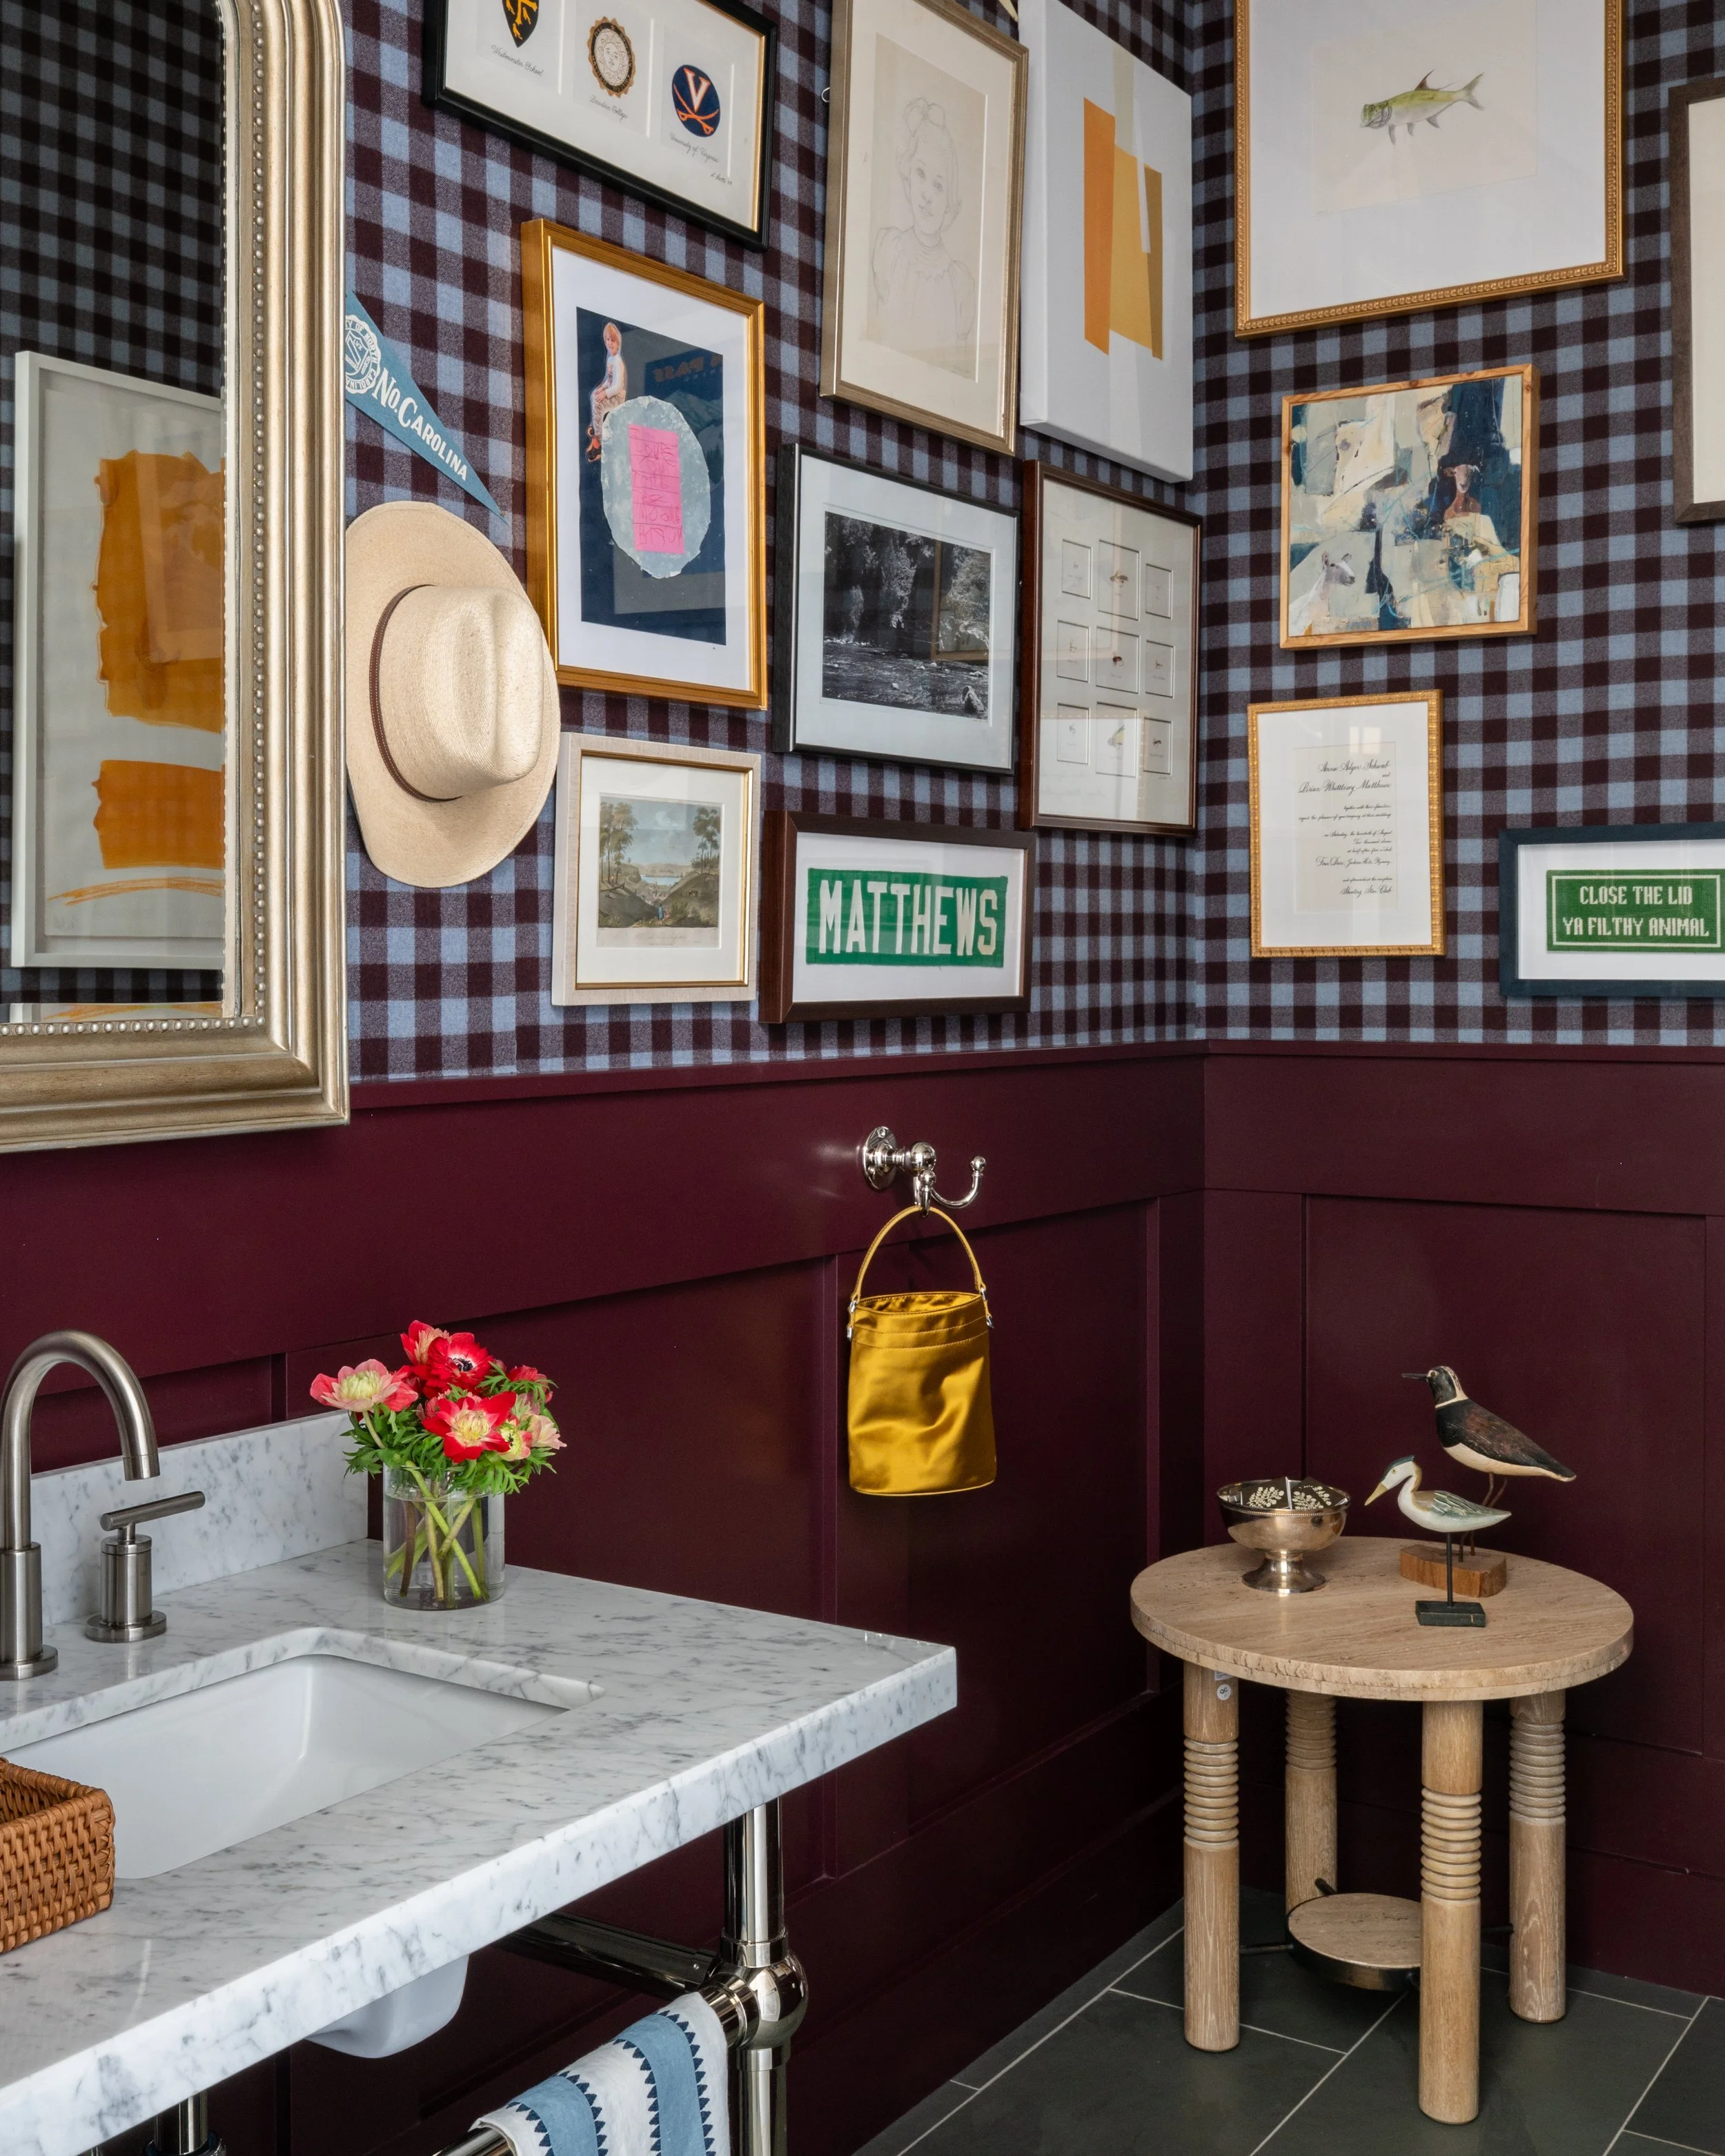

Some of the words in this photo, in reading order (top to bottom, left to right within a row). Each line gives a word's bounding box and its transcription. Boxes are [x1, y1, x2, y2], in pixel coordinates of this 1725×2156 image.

[683, 67, 711, 112] V
[355, 324, 364, 332] OF
[364, 333, 378, 364] NORTH
[398, 397, 469, 481] CAROLINA
[1298, 781, 1321, 793] Brian
[1357, 779, 1391, 789] Matthews
[1579, 886, 1627, 905] CLOSE
[1633, 886, 1663, 905] THE
[1668, 885, 1693, 905] LID
[819, 879, 998, 956] MATTHEWS
[1563, 917, 1583, 936] YA
[1588, 917, 1644, 936] FILTHY
[1648, 917, 1710, 937] ANIMAL
